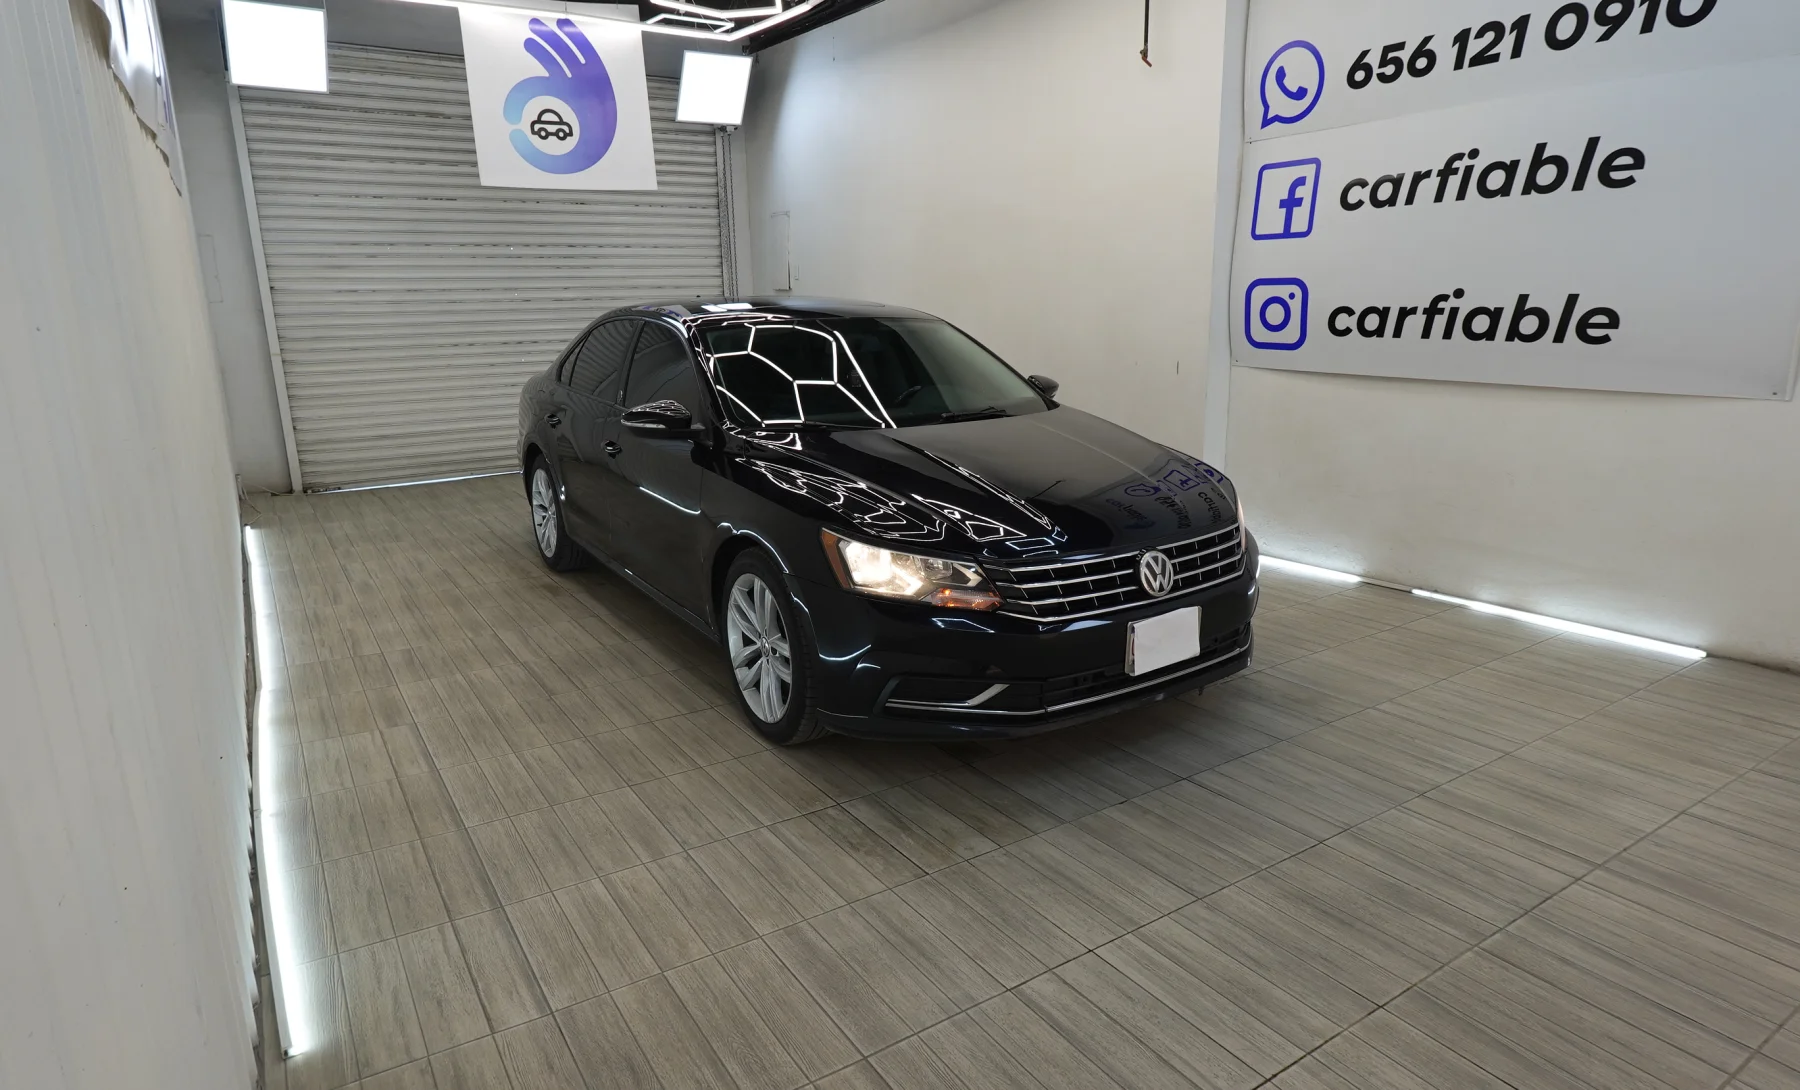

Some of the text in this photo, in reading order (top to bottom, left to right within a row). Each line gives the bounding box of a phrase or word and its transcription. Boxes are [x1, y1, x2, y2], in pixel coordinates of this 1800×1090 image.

[1346, 35, 1437, 90] 656
[1451, 13, 1531, 72] 121
[1339, 136, 1646, 212] carfiable
[1327, 288, 1620, 345] carfiable
